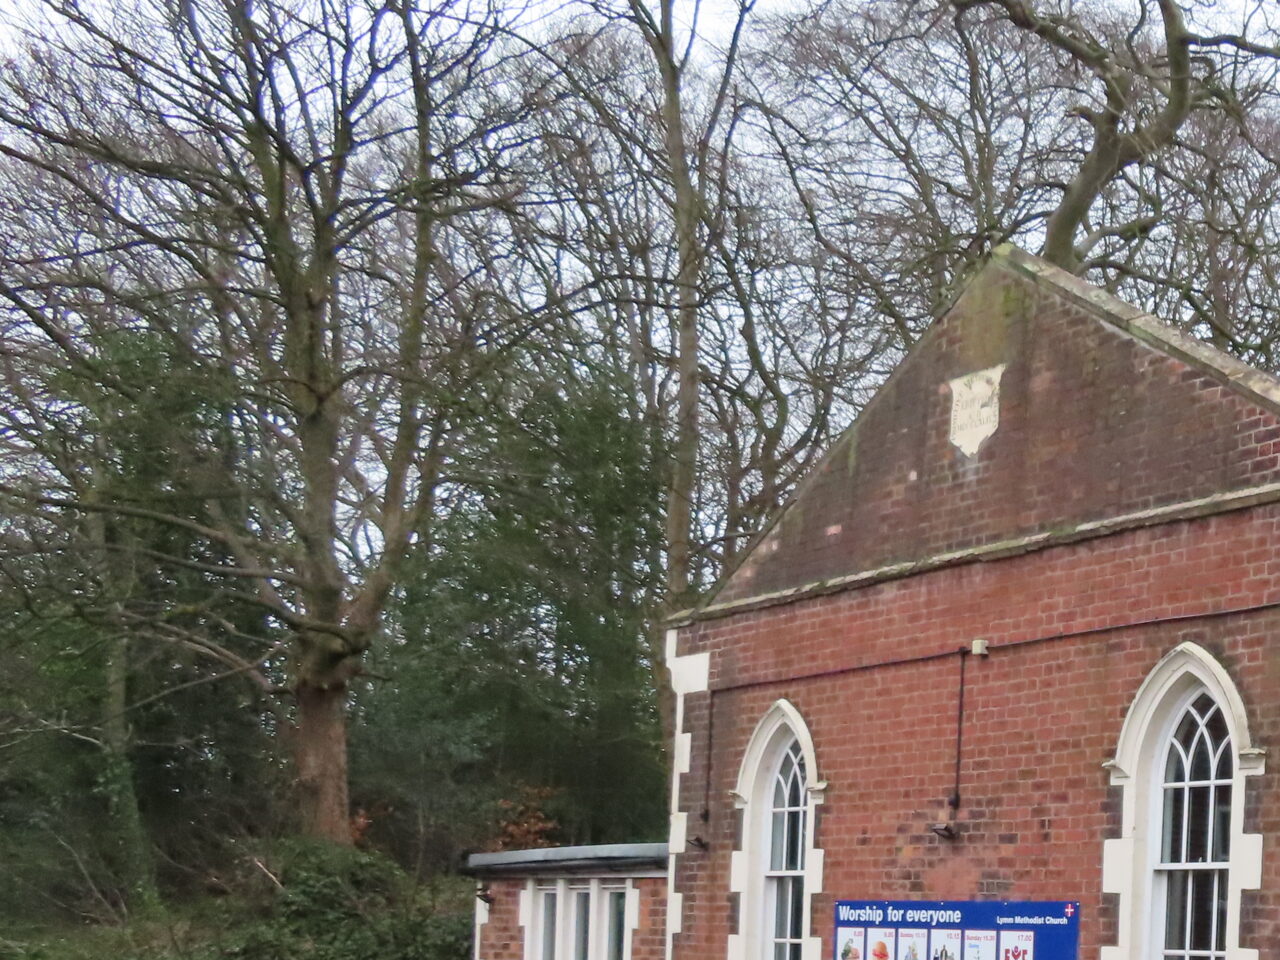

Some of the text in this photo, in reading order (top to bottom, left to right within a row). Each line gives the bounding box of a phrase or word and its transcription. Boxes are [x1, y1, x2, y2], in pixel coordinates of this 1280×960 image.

[839, 905, 962, 926] Worship for everyone
[997, 916, 1068, 925] Lymm Methodist Church
